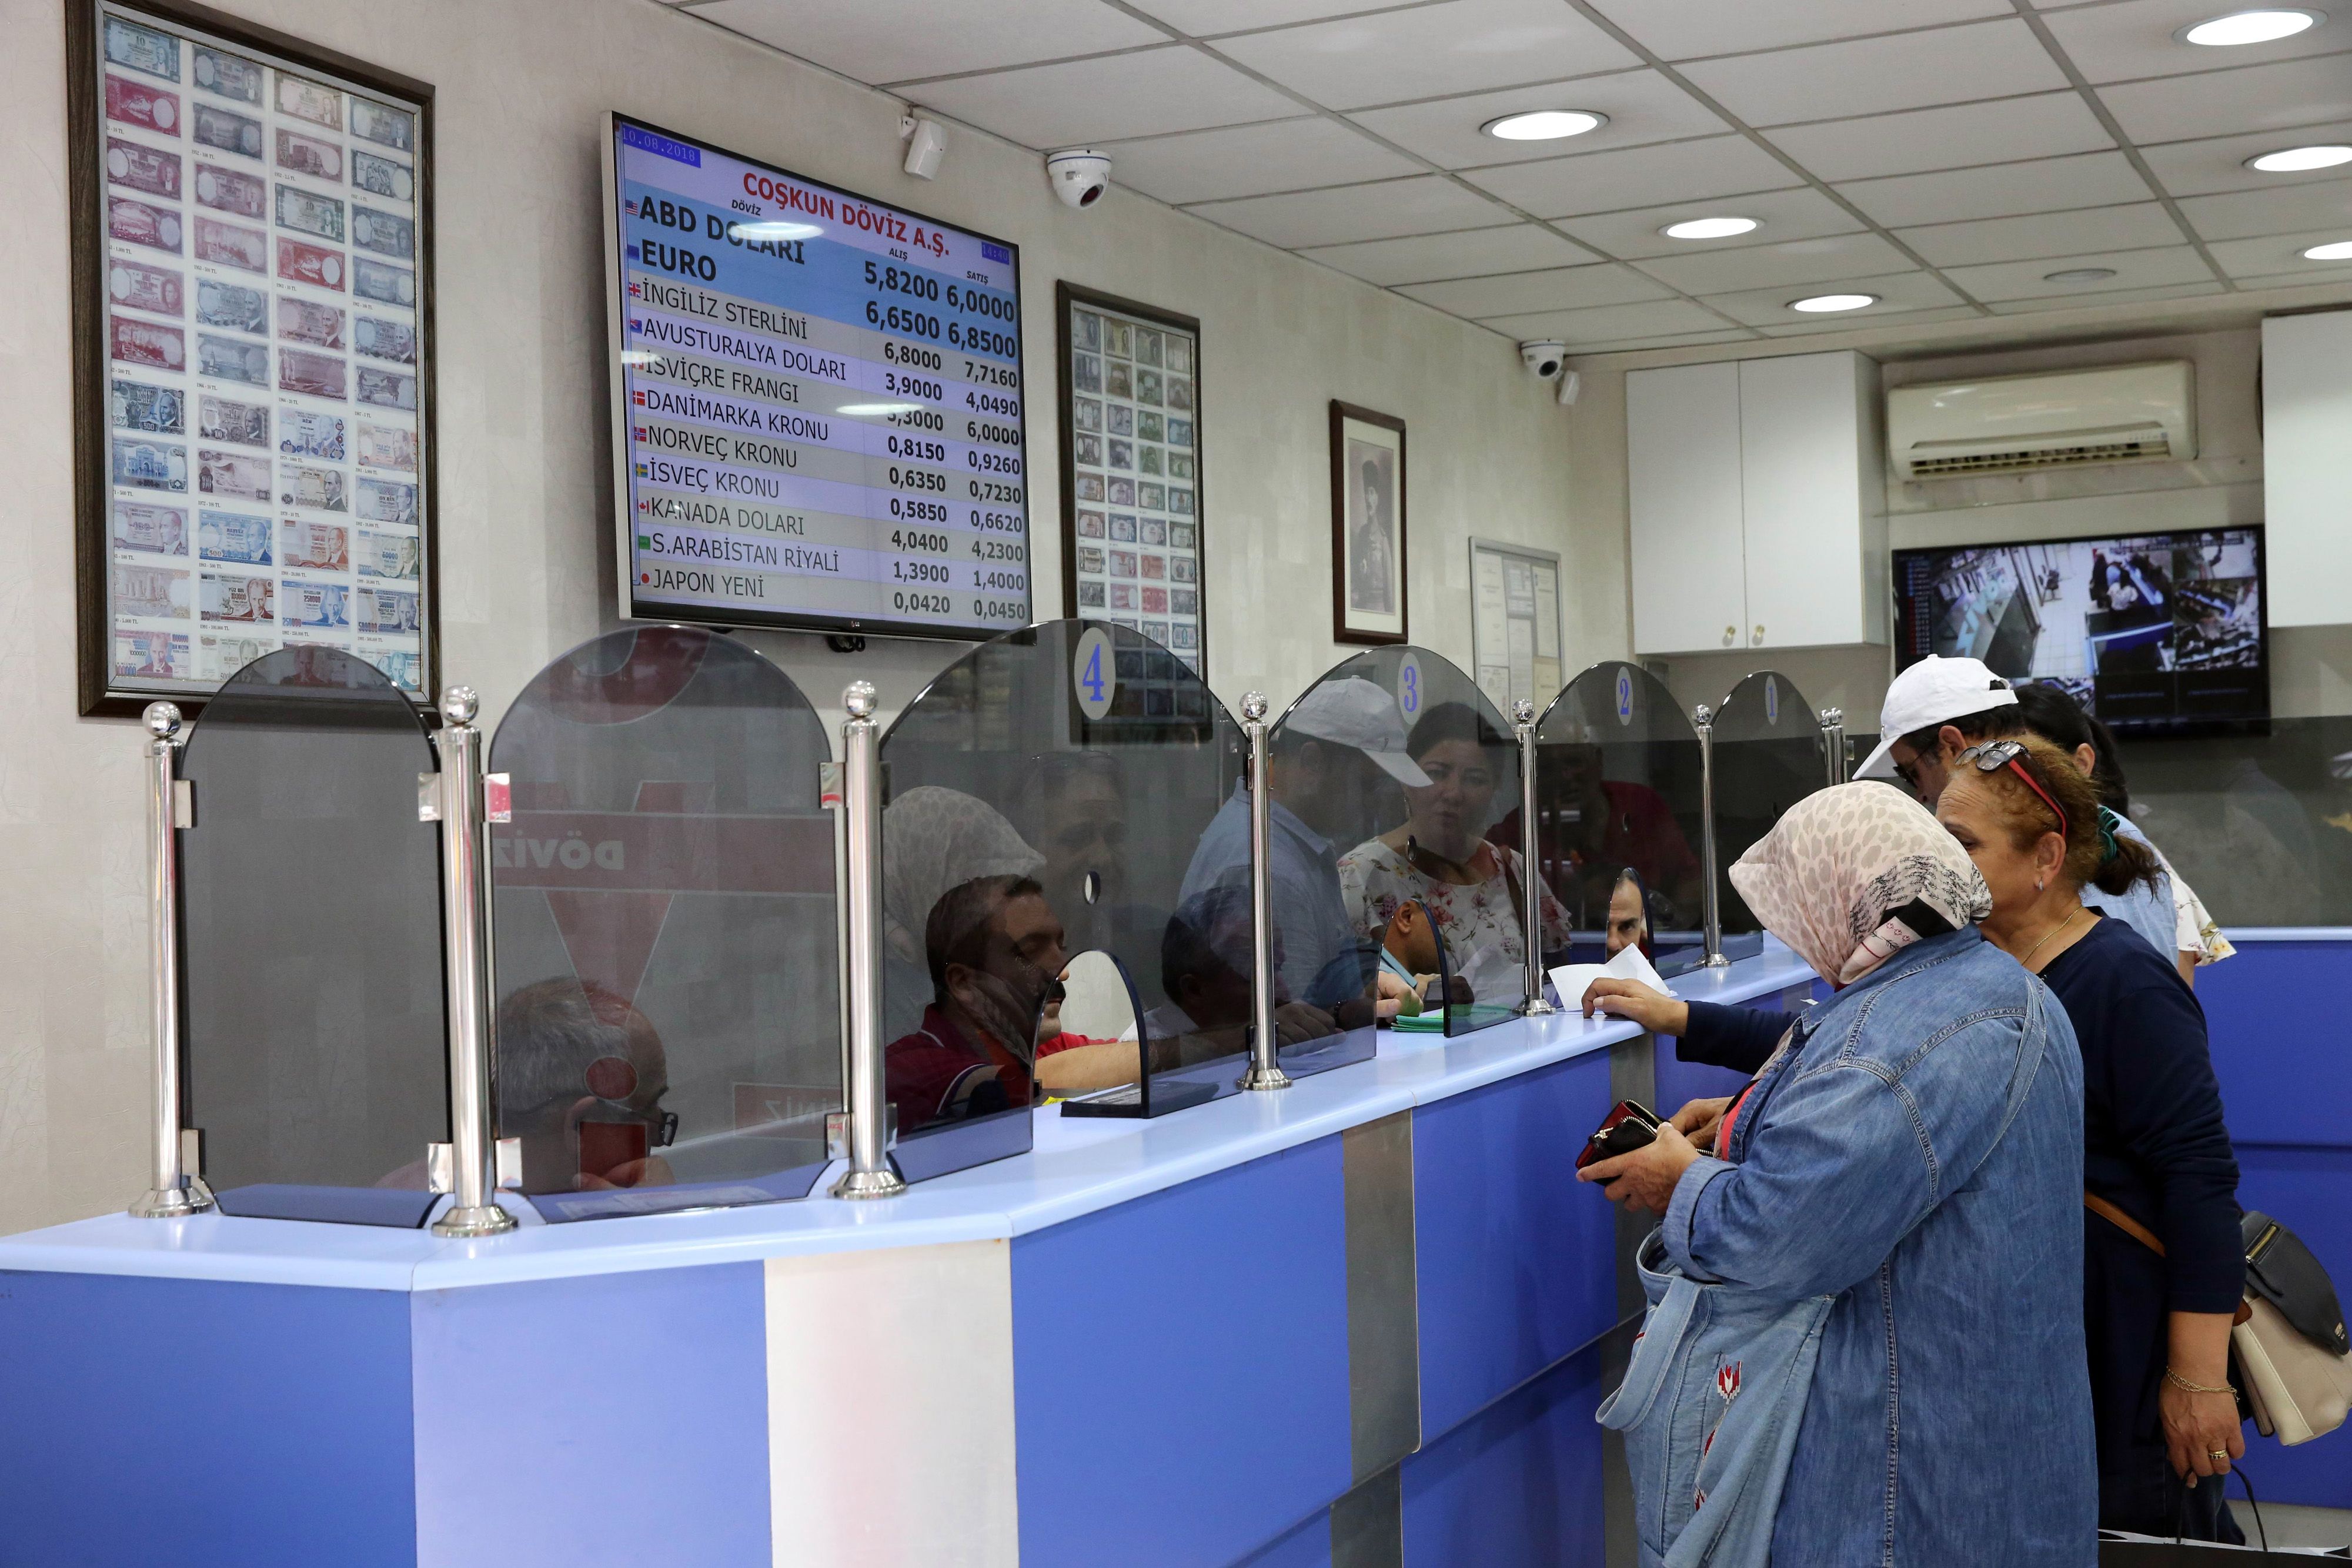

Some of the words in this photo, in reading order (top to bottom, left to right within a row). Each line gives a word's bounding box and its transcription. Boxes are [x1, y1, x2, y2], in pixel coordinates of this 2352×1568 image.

[622, 128, 695, 162] 10.08.2018
[731, 199, 761, 217] DÖVİZ
[889, 247, 908, 262] ALIŞ
[966, 269, 989, 286] SATIŞ
[744, 172, 834, 221] COŞKUN
[843, 203, 907, 243] DÖVİZ
[913, 226, 950, 258] A.Ş.
[983, 244, 1008, 261] 14:40
[640, 195, 696, 232] ABD
[864, 260, 938, 302] 5,8200
[946, 285, 1015, 323] 6,0000
[642, 239, 716, 282] EURO
[866, 300, 940, 340] 6,6500
[948, 321, 1017, 360] 6,8500
[643, 278, 718, 319] İNGİLİZ
[726, 302, 808, 339] STERLİNİ
[884, 341, 941, 370] 6,8000
[965, 361, 1018, 389] 7,7160
[644, 319, 777, 366] AVUSTURALYA
[783, 348, 847, 381] DOLARI
[886, 373, 943, 401] 3,9000
[965, 392, 1018, 417] 4,0490
[646, 350, 724, 388] İSVİÇRE
[733, 372, 799, 403] FRANGI
[967, 422, 1020, 446] 6,0000
[647, 389, 762, 430] DANİMARKA
[769, 413, 829, 441] KRONU
[888, 436, 945, 462] 0,8150
[968, 451, 1021, 476] 0,9260
[649, 424, 729, 460] NORVEÇ
[735, 444, 797, 469] KRONU
[889, 466, 947, 493] 0,6350
[970, 480, 1022, 504] 0,7230
[650, 457, 709, 493] İSVEÇ
[716, 476, 779, 499] KRONU
[890, 498, 947, 523] 0,5850
[971, 510, 1023, 533] 0,6620
[652, 497, 730, 526] KANADA
[739, 509, 804, 536] DOLARI
[891, 530, 948, 553] 4,0400
[971, 540, 1024, 563] 4,2300
[652, 533, 777, 567] S.ARABİSTAN
[785, 548, 839, 573] RİYALİ
[894, 561, 950, 584] 1,3900
[973, 570, 1025, 592] 1,4000
[653, 569, 715, 594] JAPON
[721, 574, 765, 599] YENİ
[894, 592, 951, 614] 0,0420
[973, 600, 1025, 621] 0,0450
[1082, 643, 1105, 702] 4
[1404, 665, 1418, 713] 3
[1619, 677, 1630, 716] 2
[1768, 684, 1776, 718] 1
